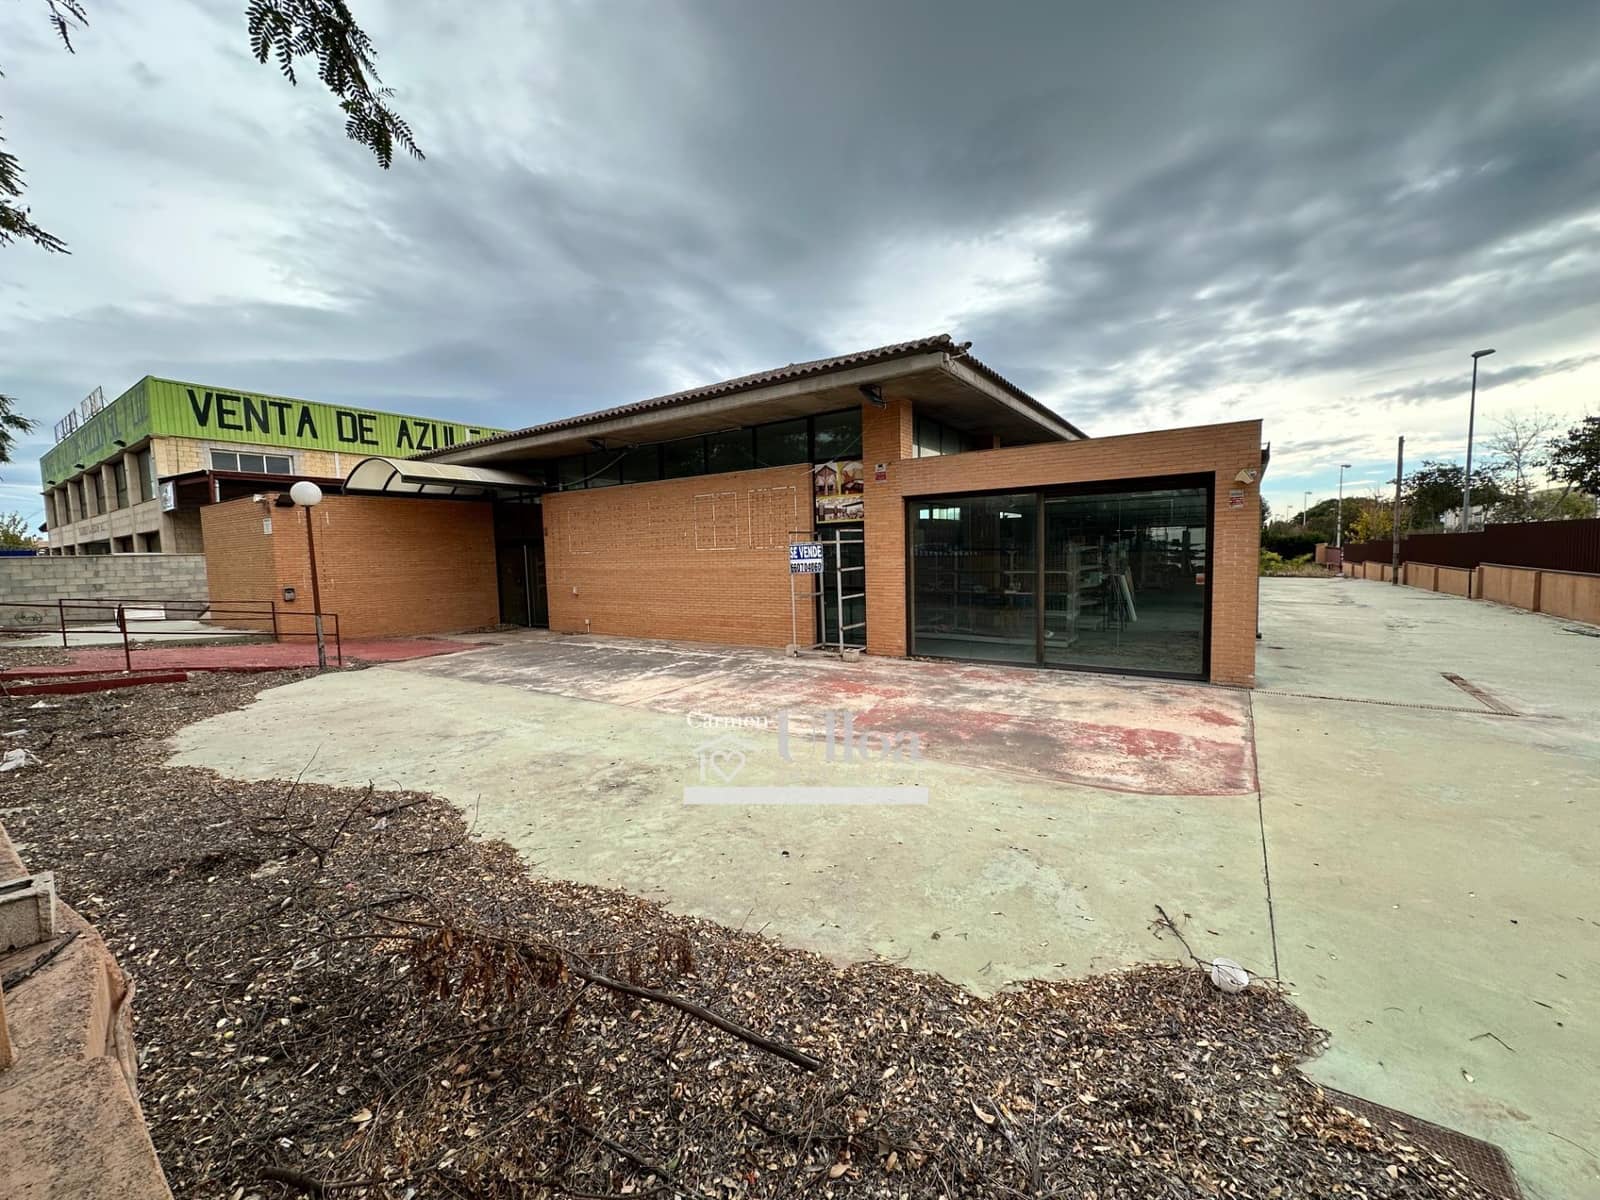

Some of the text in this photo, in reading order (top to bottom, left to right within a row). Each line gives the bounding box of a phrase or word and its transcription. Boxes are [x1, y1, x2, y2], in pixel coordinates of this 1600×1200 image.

[187, 389, 496, 450] VENTA DE AZUL
[790, 545, 822, 558] SE VENDE
